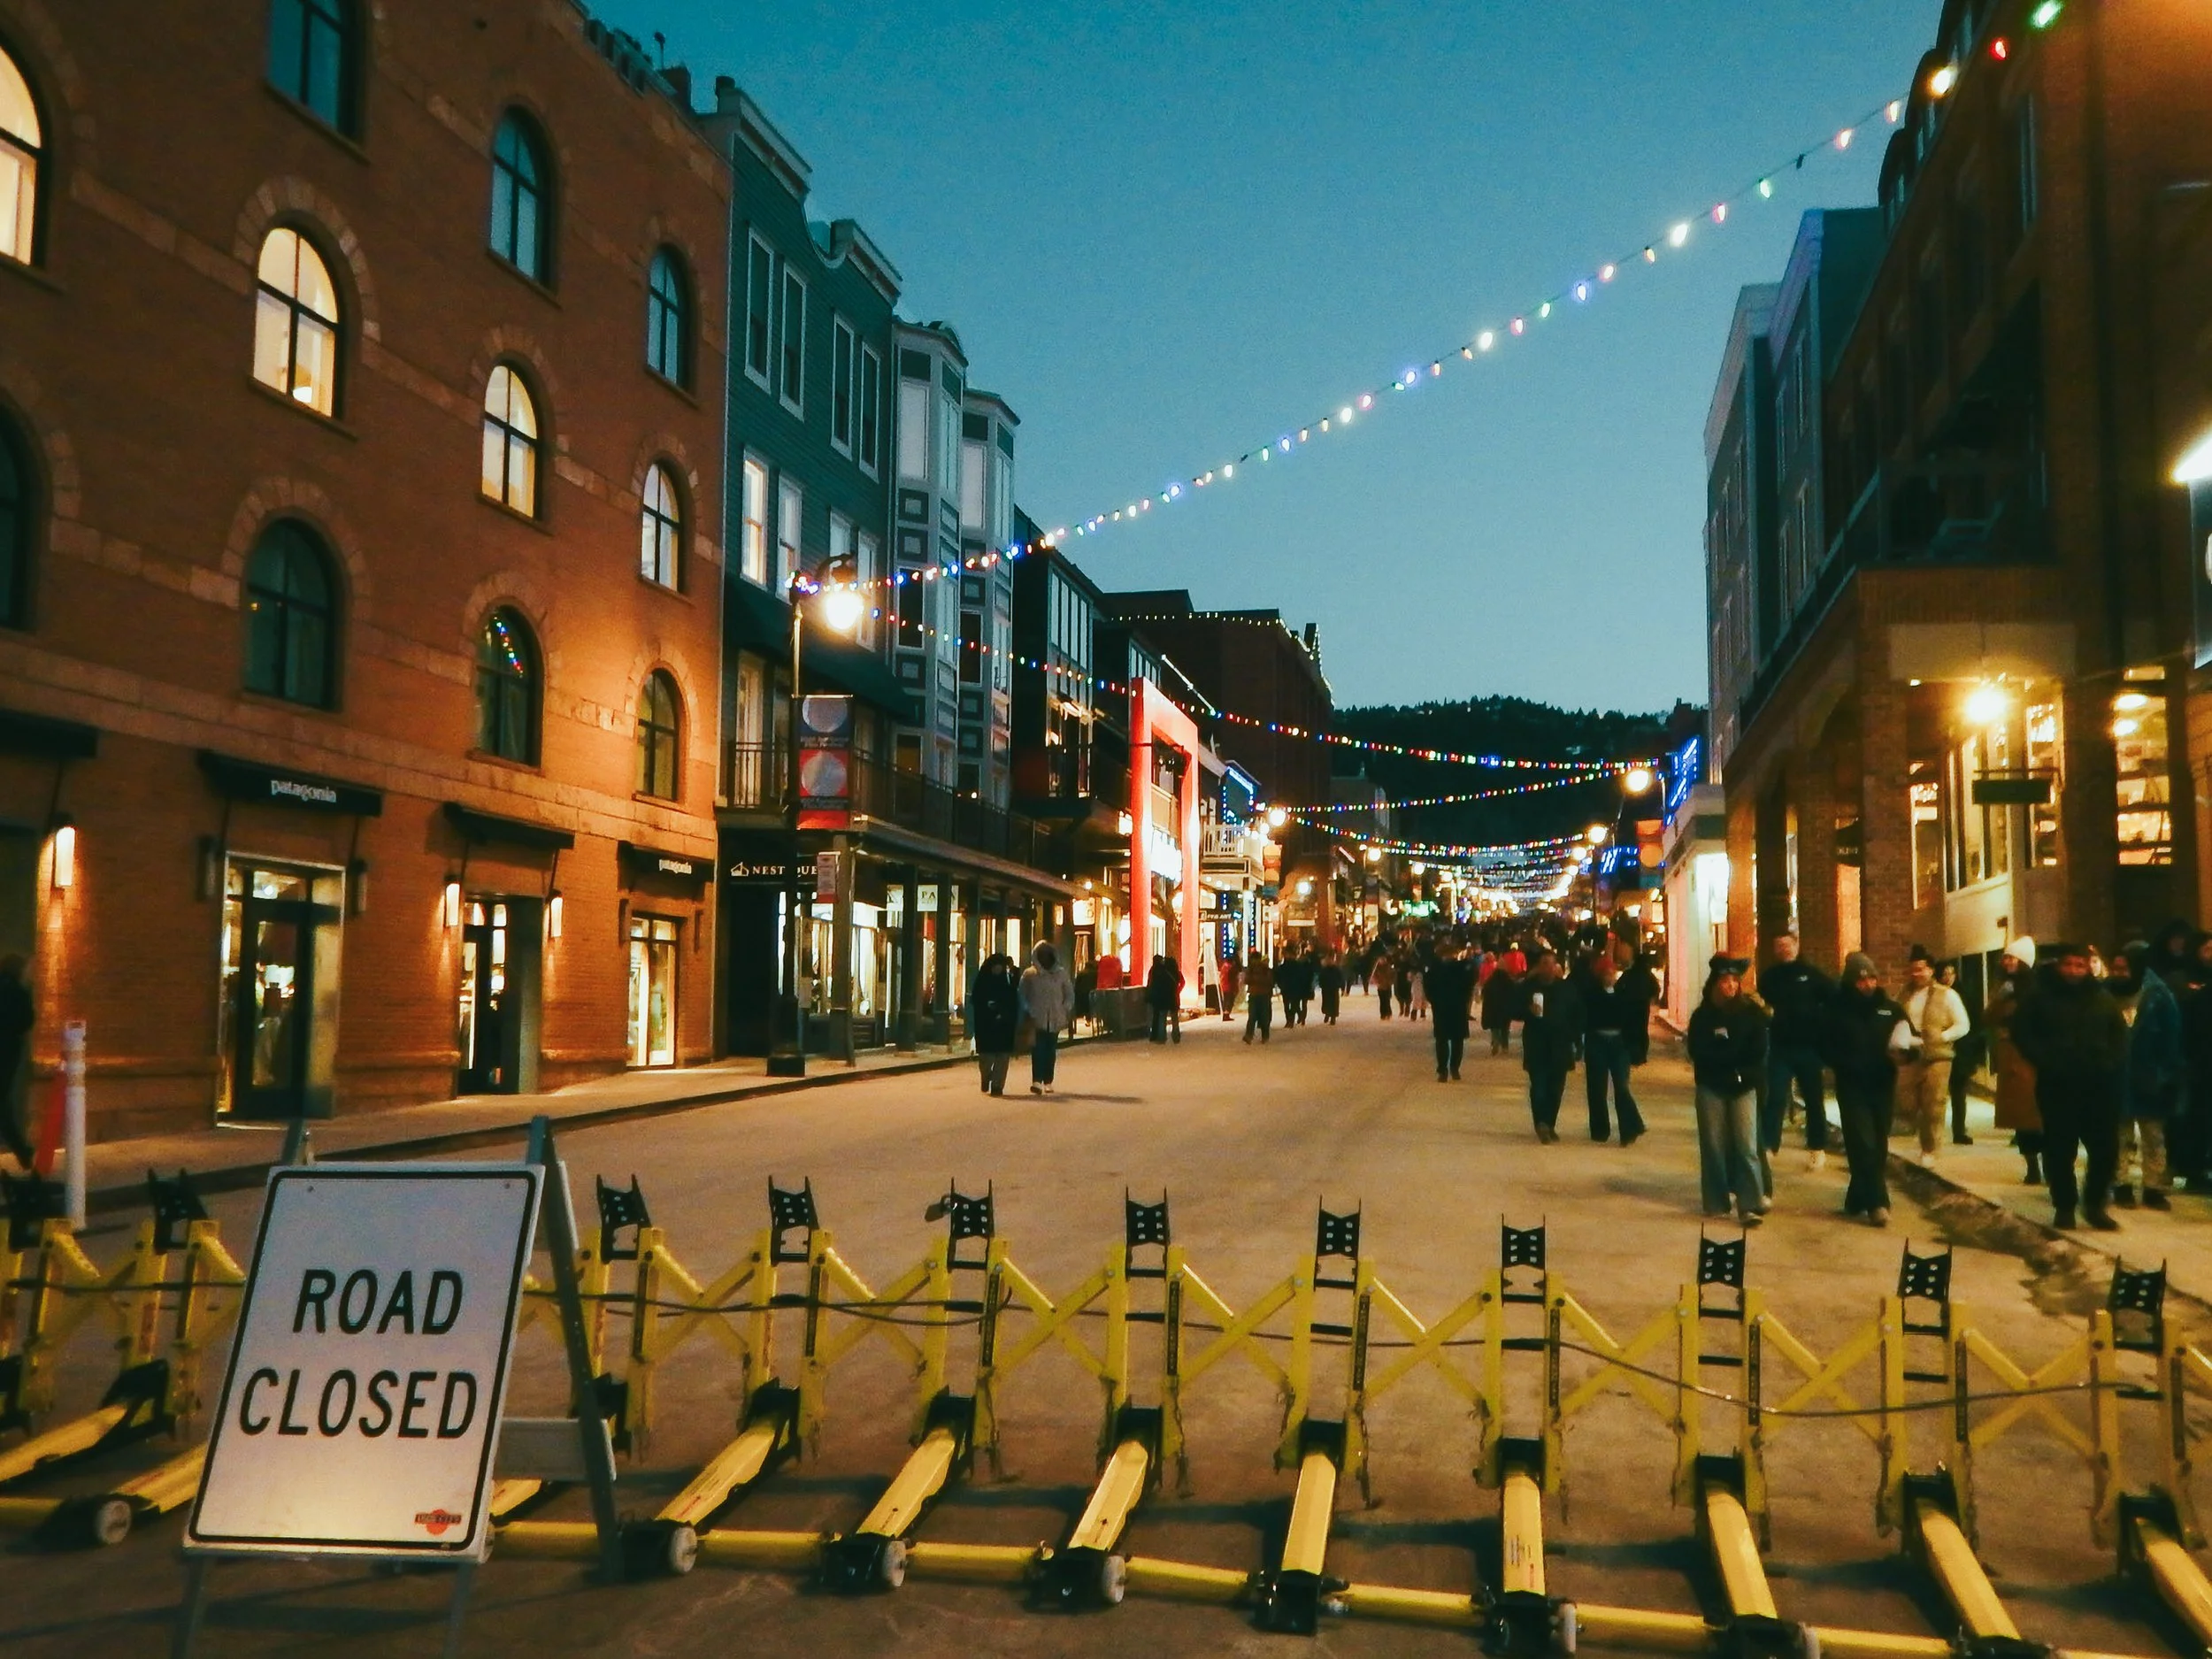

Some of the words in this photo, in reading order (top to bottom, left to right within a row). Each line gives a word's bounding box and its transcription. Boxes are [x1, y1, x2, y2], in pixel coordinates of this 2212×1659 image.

[271, 780, 337, 803] patagonia
[752, 865, 786, 875] NEST
[293, 1268, 464, 1335] ROAD
[239, 1368, 477, 1440] CLOSED
